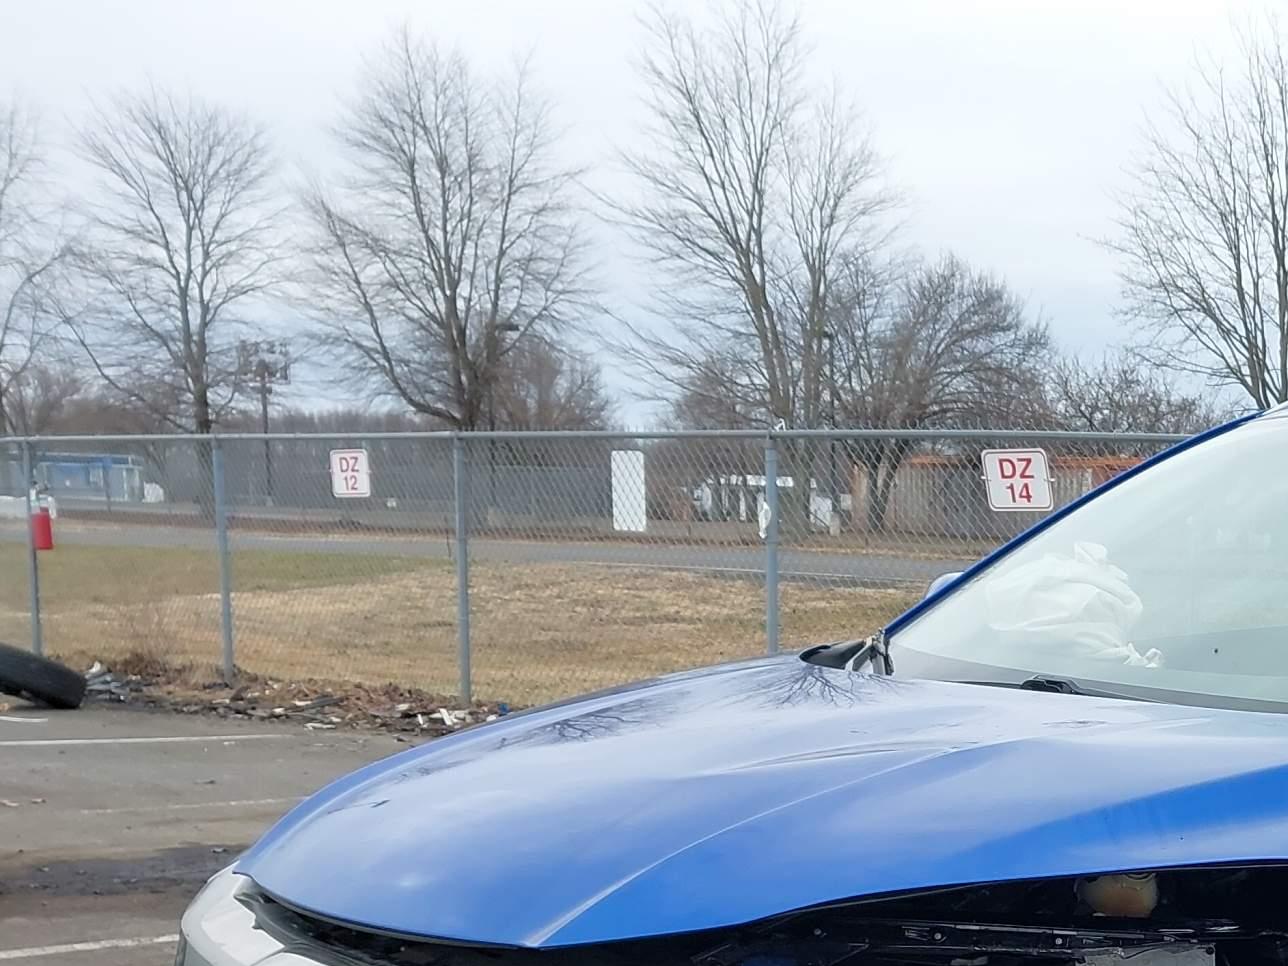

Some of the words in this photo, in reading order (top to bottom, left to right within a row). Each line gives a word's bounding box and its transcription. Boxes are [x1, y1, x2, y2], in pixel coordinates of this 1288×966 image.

[338, 456, 360, 473] DZ
[997, 457, 1035, 480] DZ
[343, 475, 359, 491] 12
[1006, 482, 1033, 503] 14
